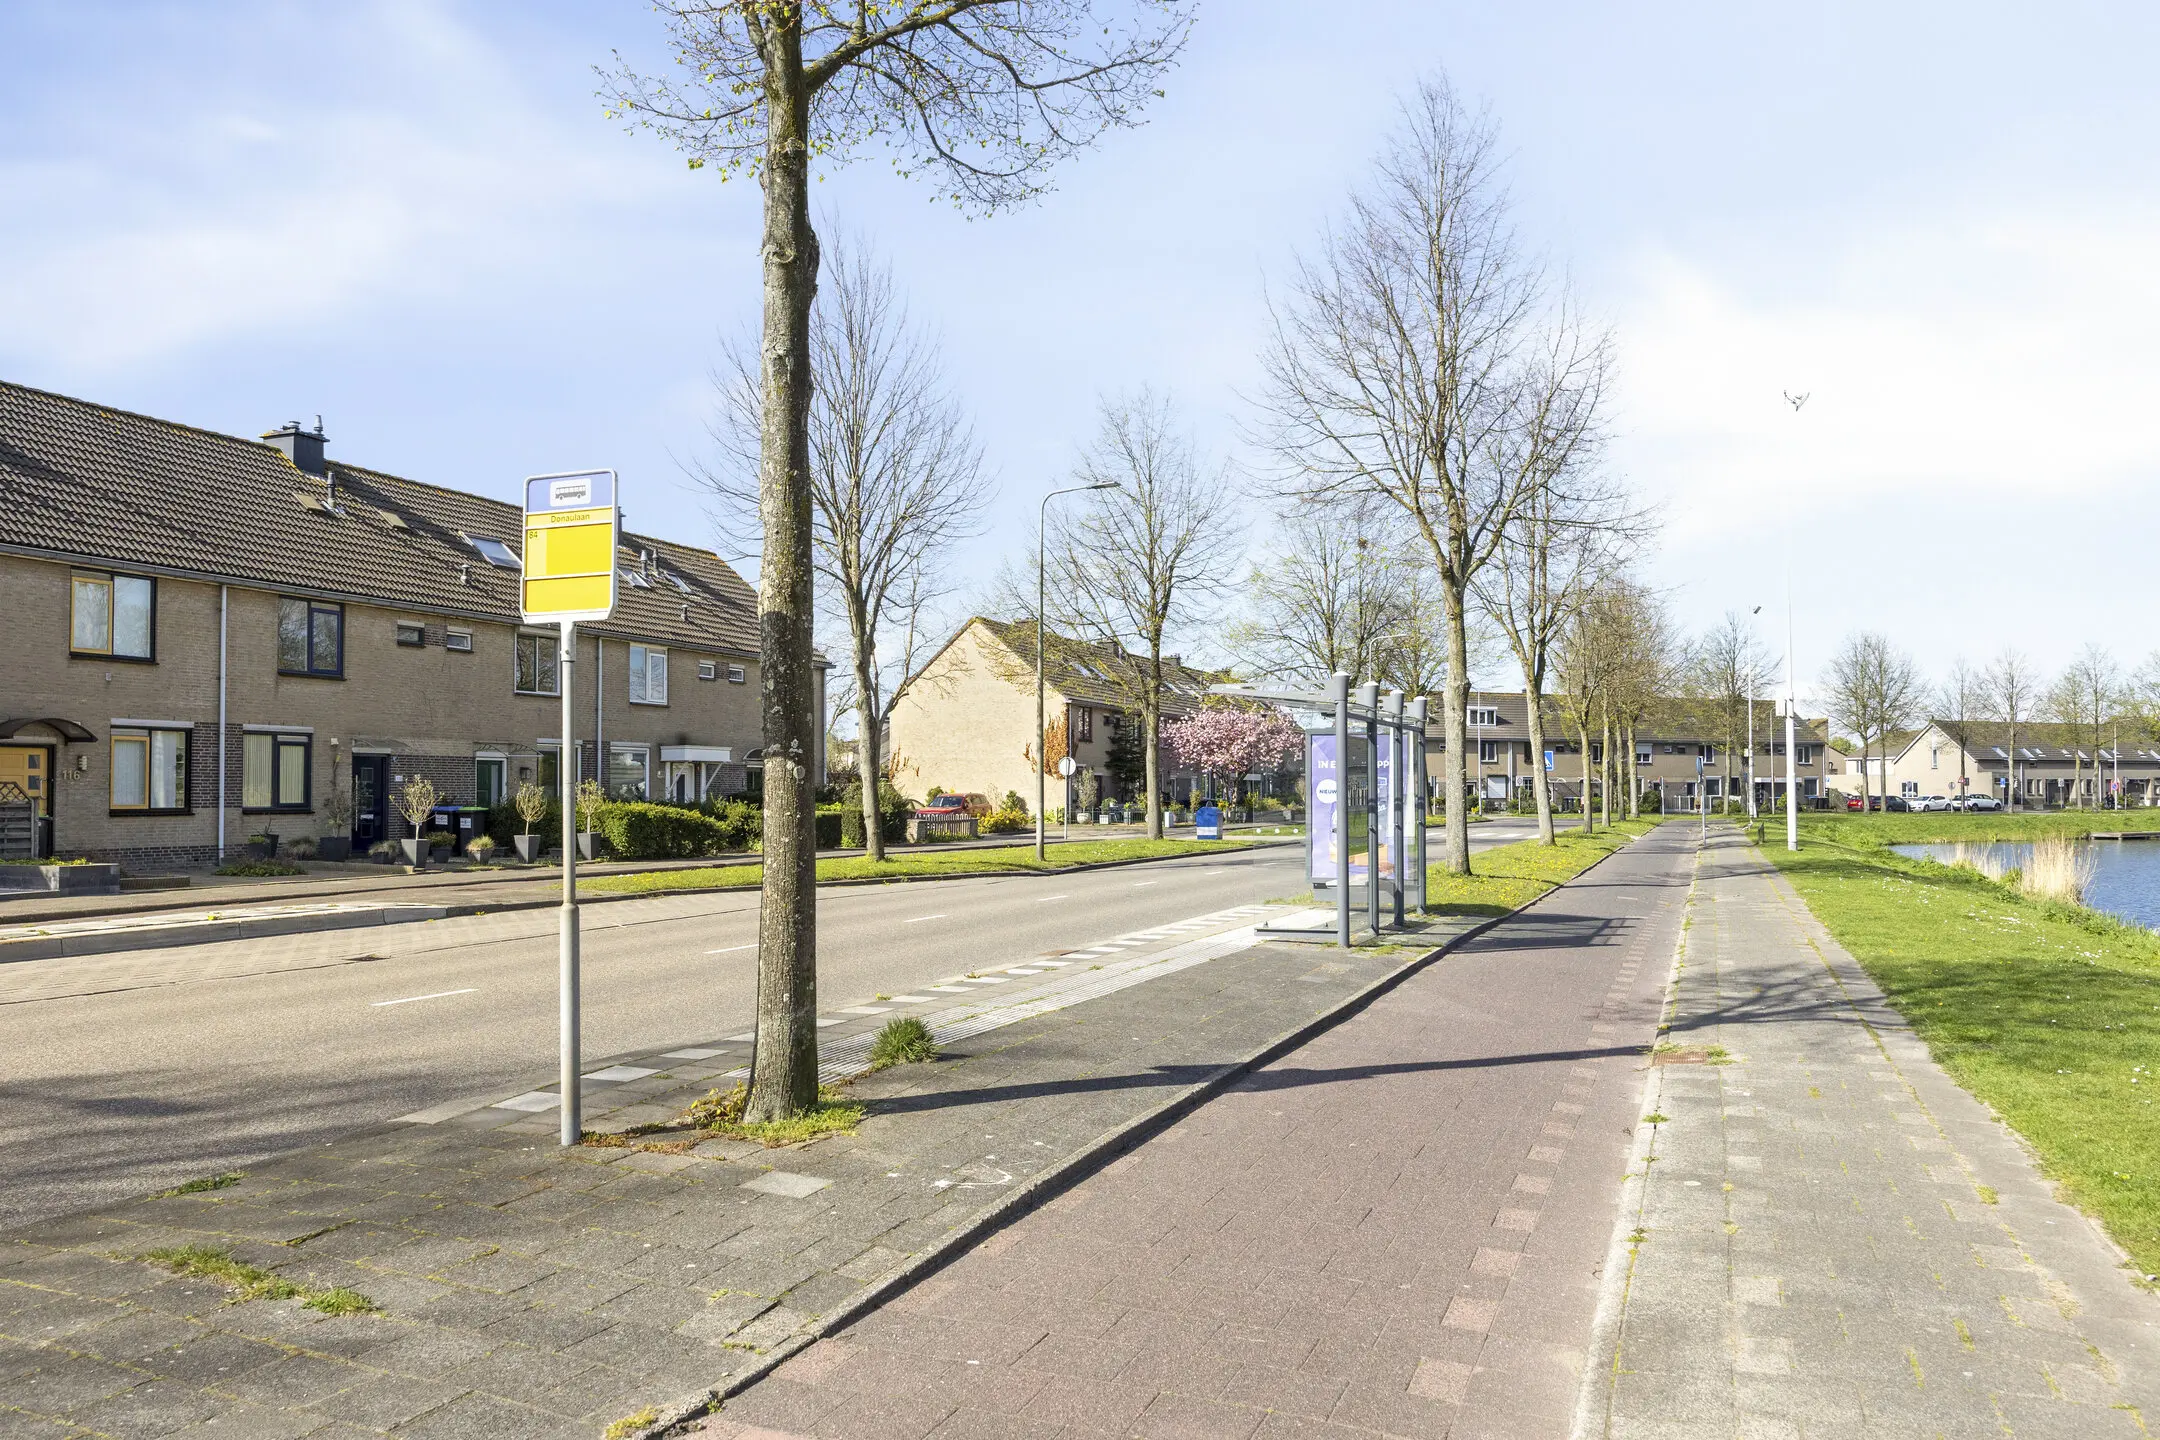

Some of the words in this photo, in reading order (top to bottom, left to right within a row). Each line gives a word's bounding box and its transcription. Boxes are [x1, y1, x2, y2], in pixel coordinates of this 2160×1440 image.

[550, 514, 590, 523] Donaulaan
[1318, 760, 1329, 769] IN
[62, 770, 80, 780] 116
